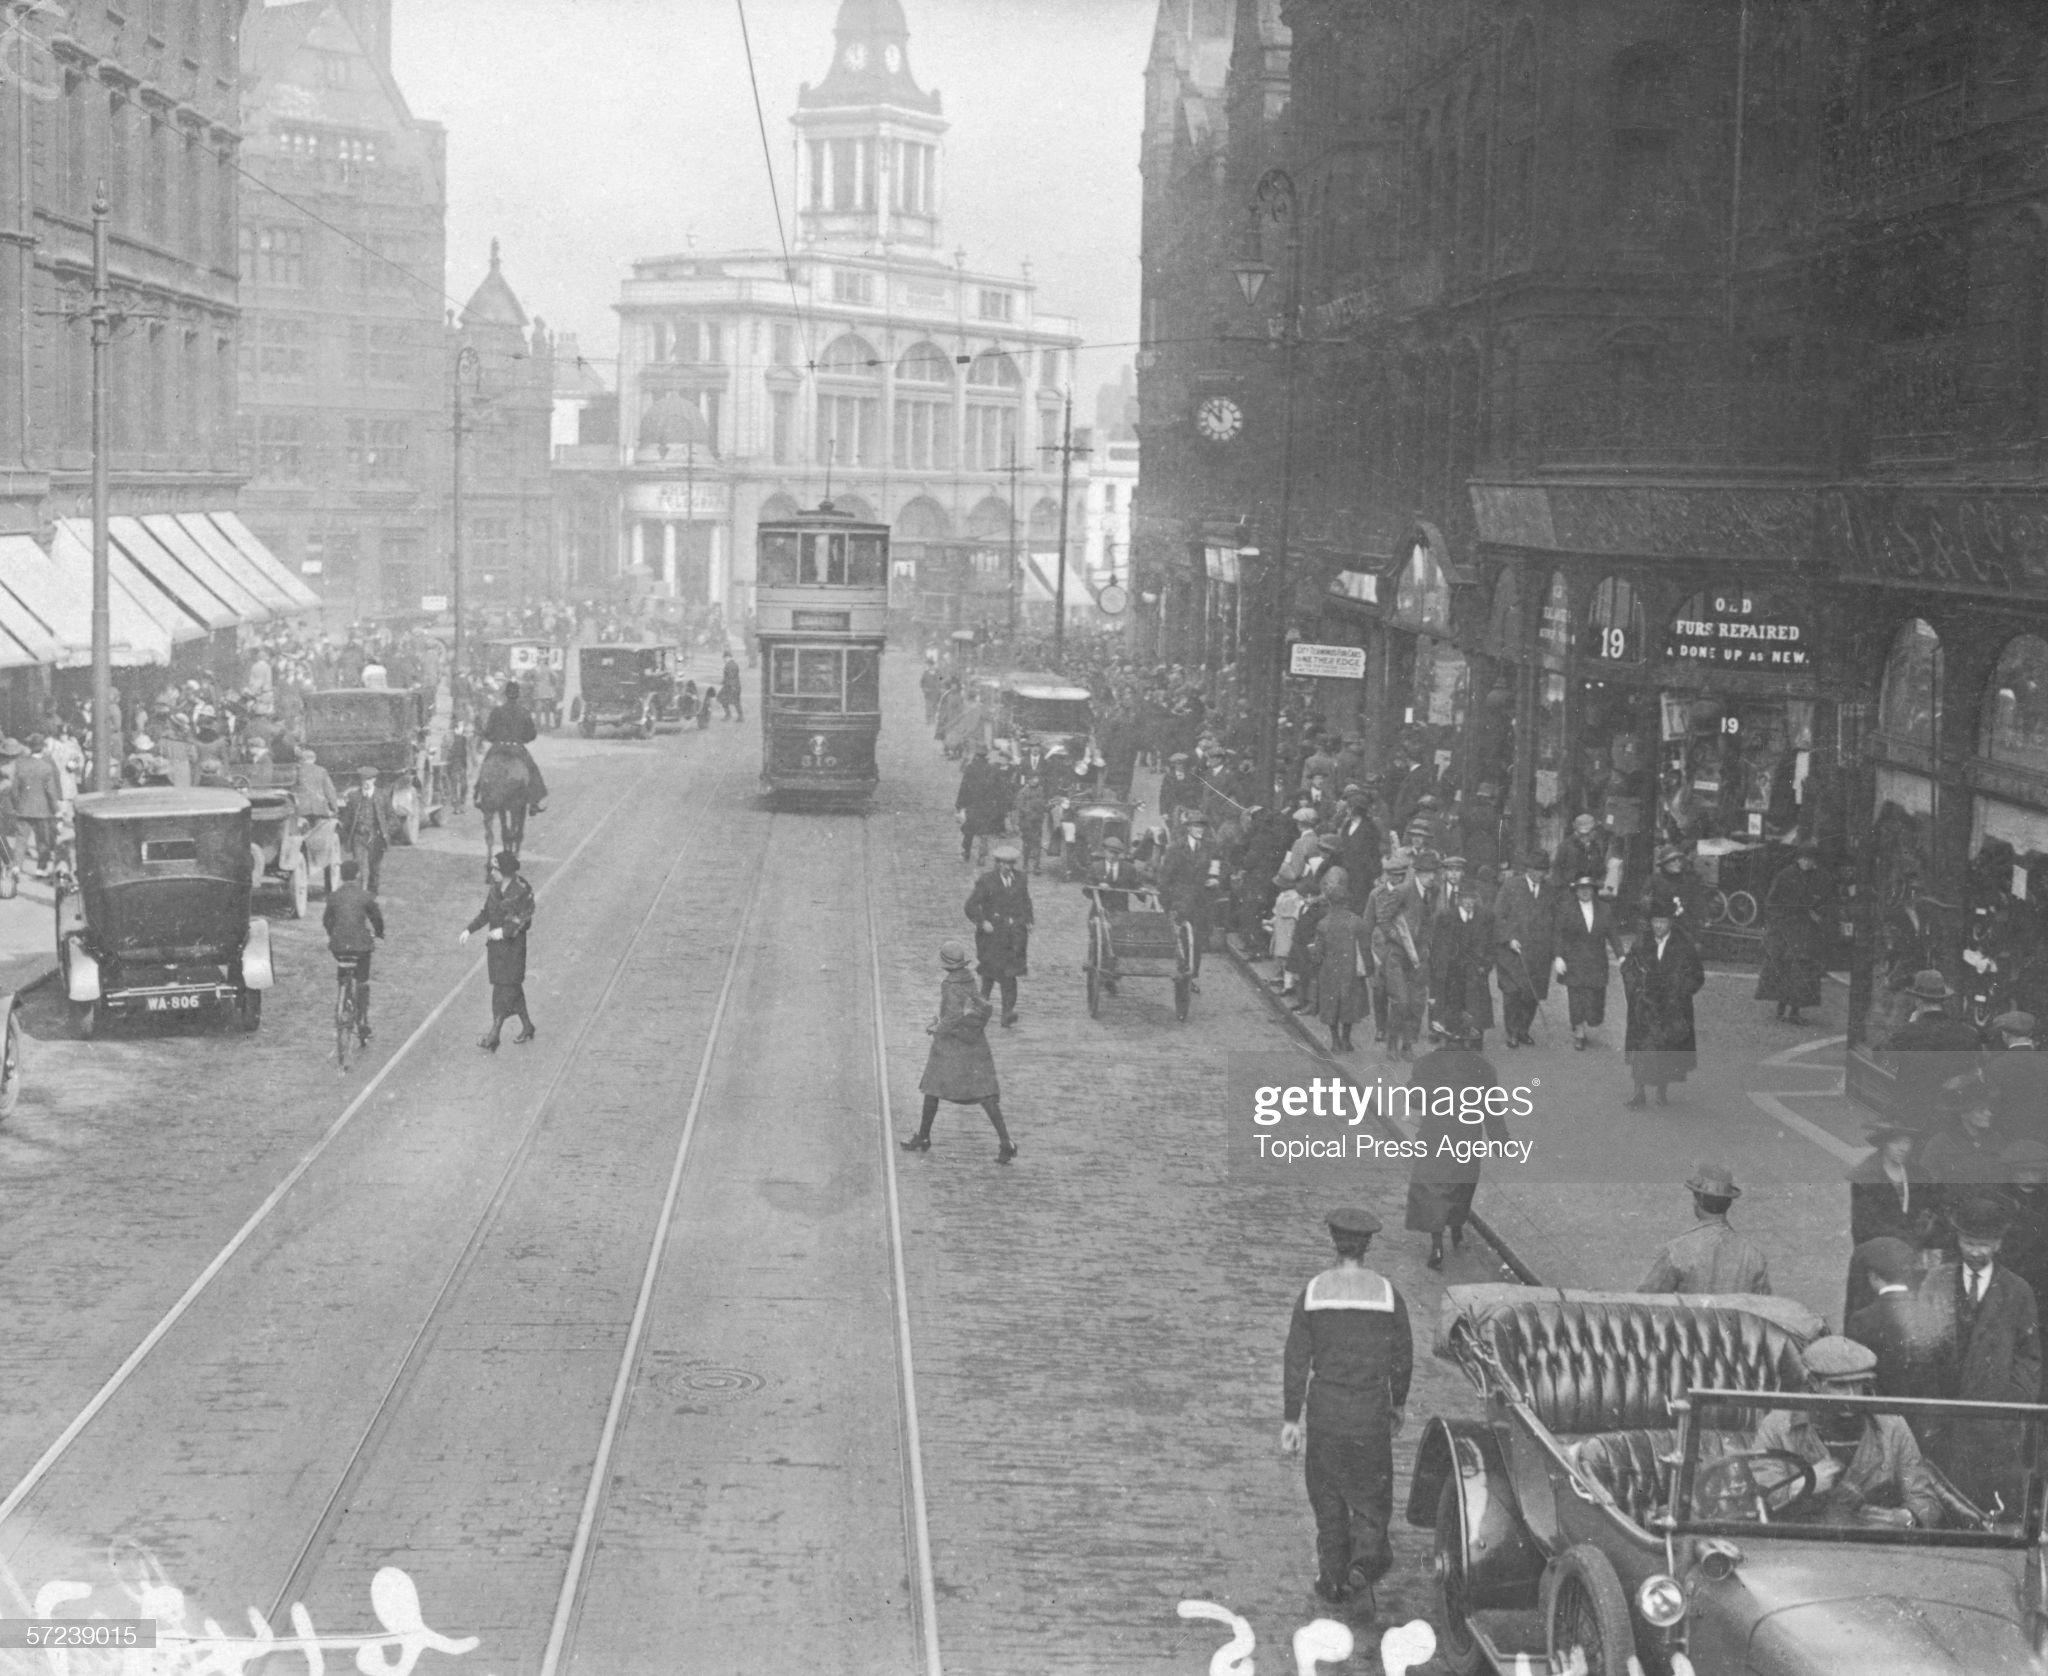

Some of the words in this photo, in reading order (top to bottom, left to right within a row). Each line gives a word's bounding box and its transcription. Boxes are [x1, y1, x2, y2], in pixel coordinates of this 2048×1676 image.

[1676, 620, 1714, 636] FURS
[1718, 623, 1800, 641] REPAIRED
[1601, 627, 1624, 659] 19
[1680, 645, 1716, 659] DONE
[1724, 649, 1743, 661] UP
[1749, 651, 1764, 662] AS
[1772, 651, 1810, 664] NEW.
[1720, 716, 1739, 734] 19
